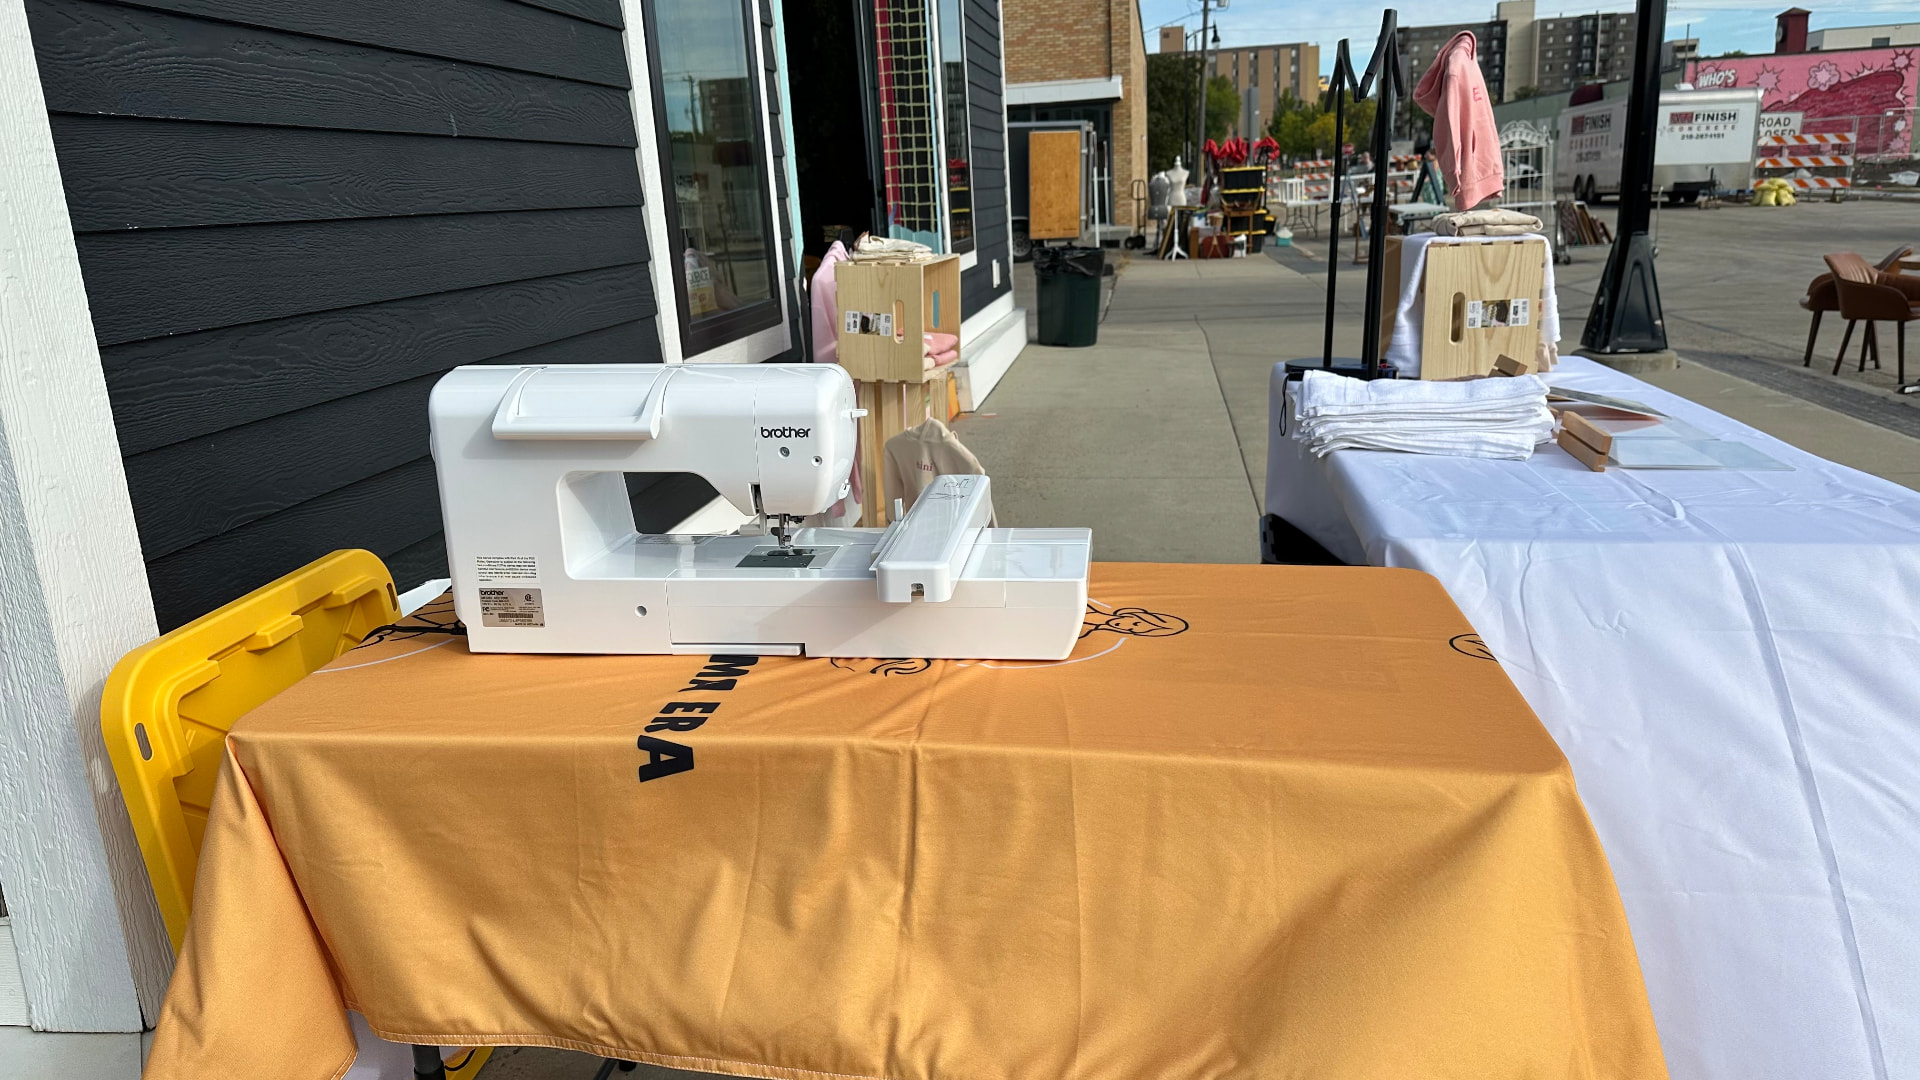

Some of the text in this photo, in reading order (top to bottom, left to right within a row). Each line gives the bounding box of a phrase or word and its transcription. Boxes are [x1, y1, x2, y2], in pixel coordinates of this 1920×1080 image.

[1698, 69, 1736, 88] WHO'S
[1694, 112, 1737, 122] FINISH
[1759, 116, 1791, 128] ROAD
[1669, 124, 1736, 132] CONCRETE
[1757, 129, 1796, 137] OSED
[760, 426, 811, 438] brother
[637, 702, 721, 783] ERA
